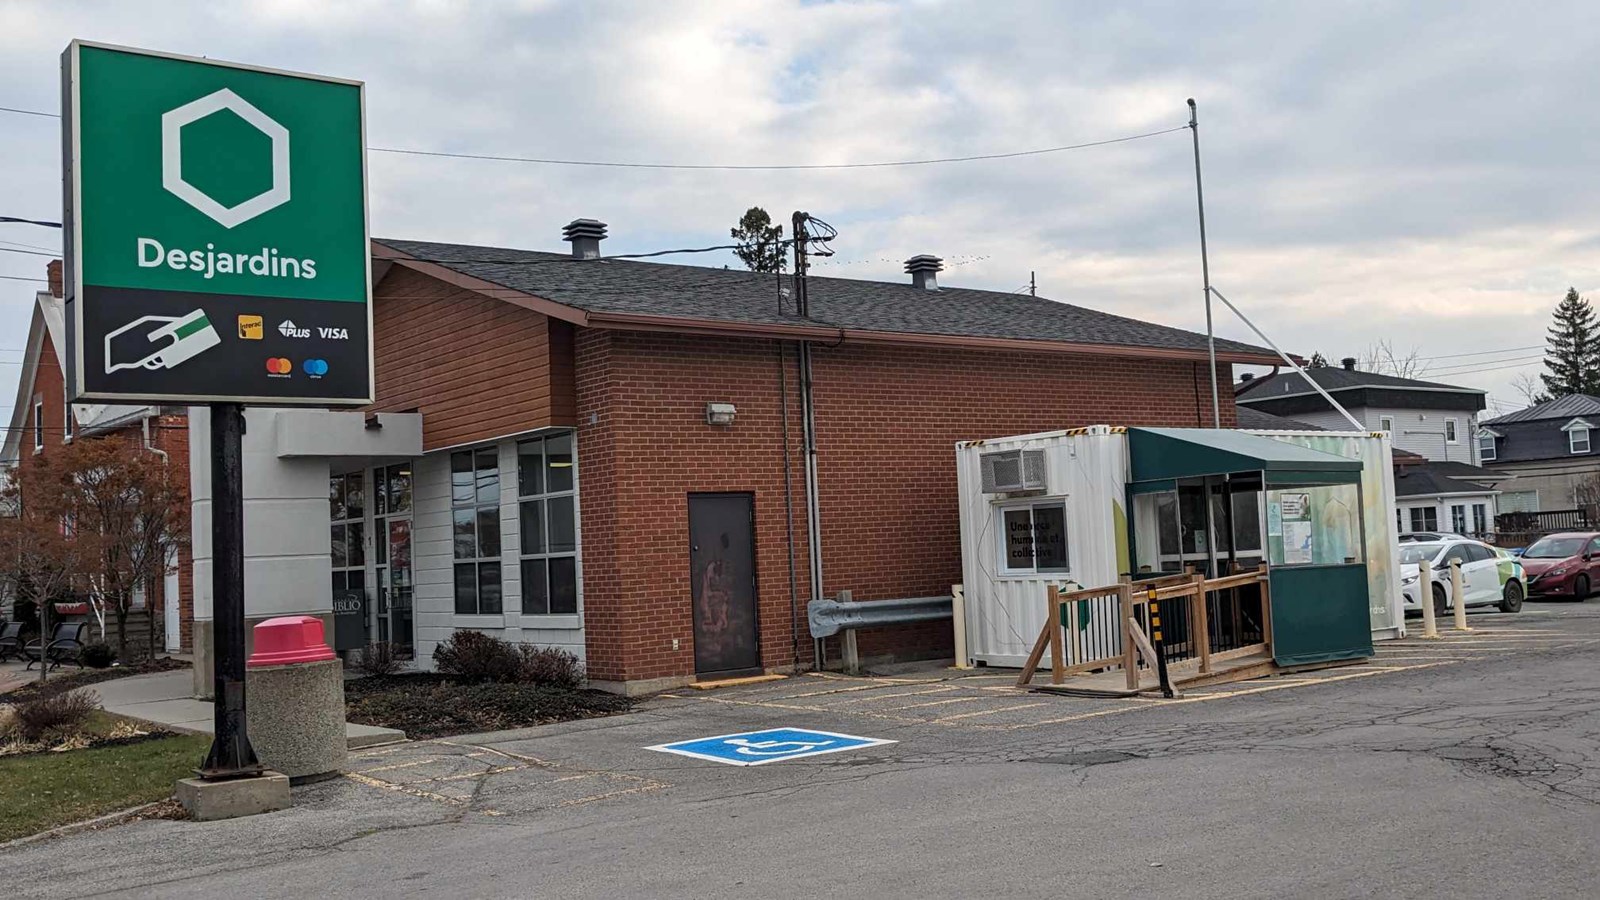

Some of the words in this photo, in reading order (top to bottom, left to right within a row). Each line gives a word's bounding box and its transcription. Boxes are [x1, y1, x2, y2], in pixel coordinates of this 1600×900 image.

[137, 237, 317, 279] Desjardins
[286, 328, 311, 338] PLUS
[317, 327, 349, 340] VISA
[334, 600, 361, 612] IBLIO
